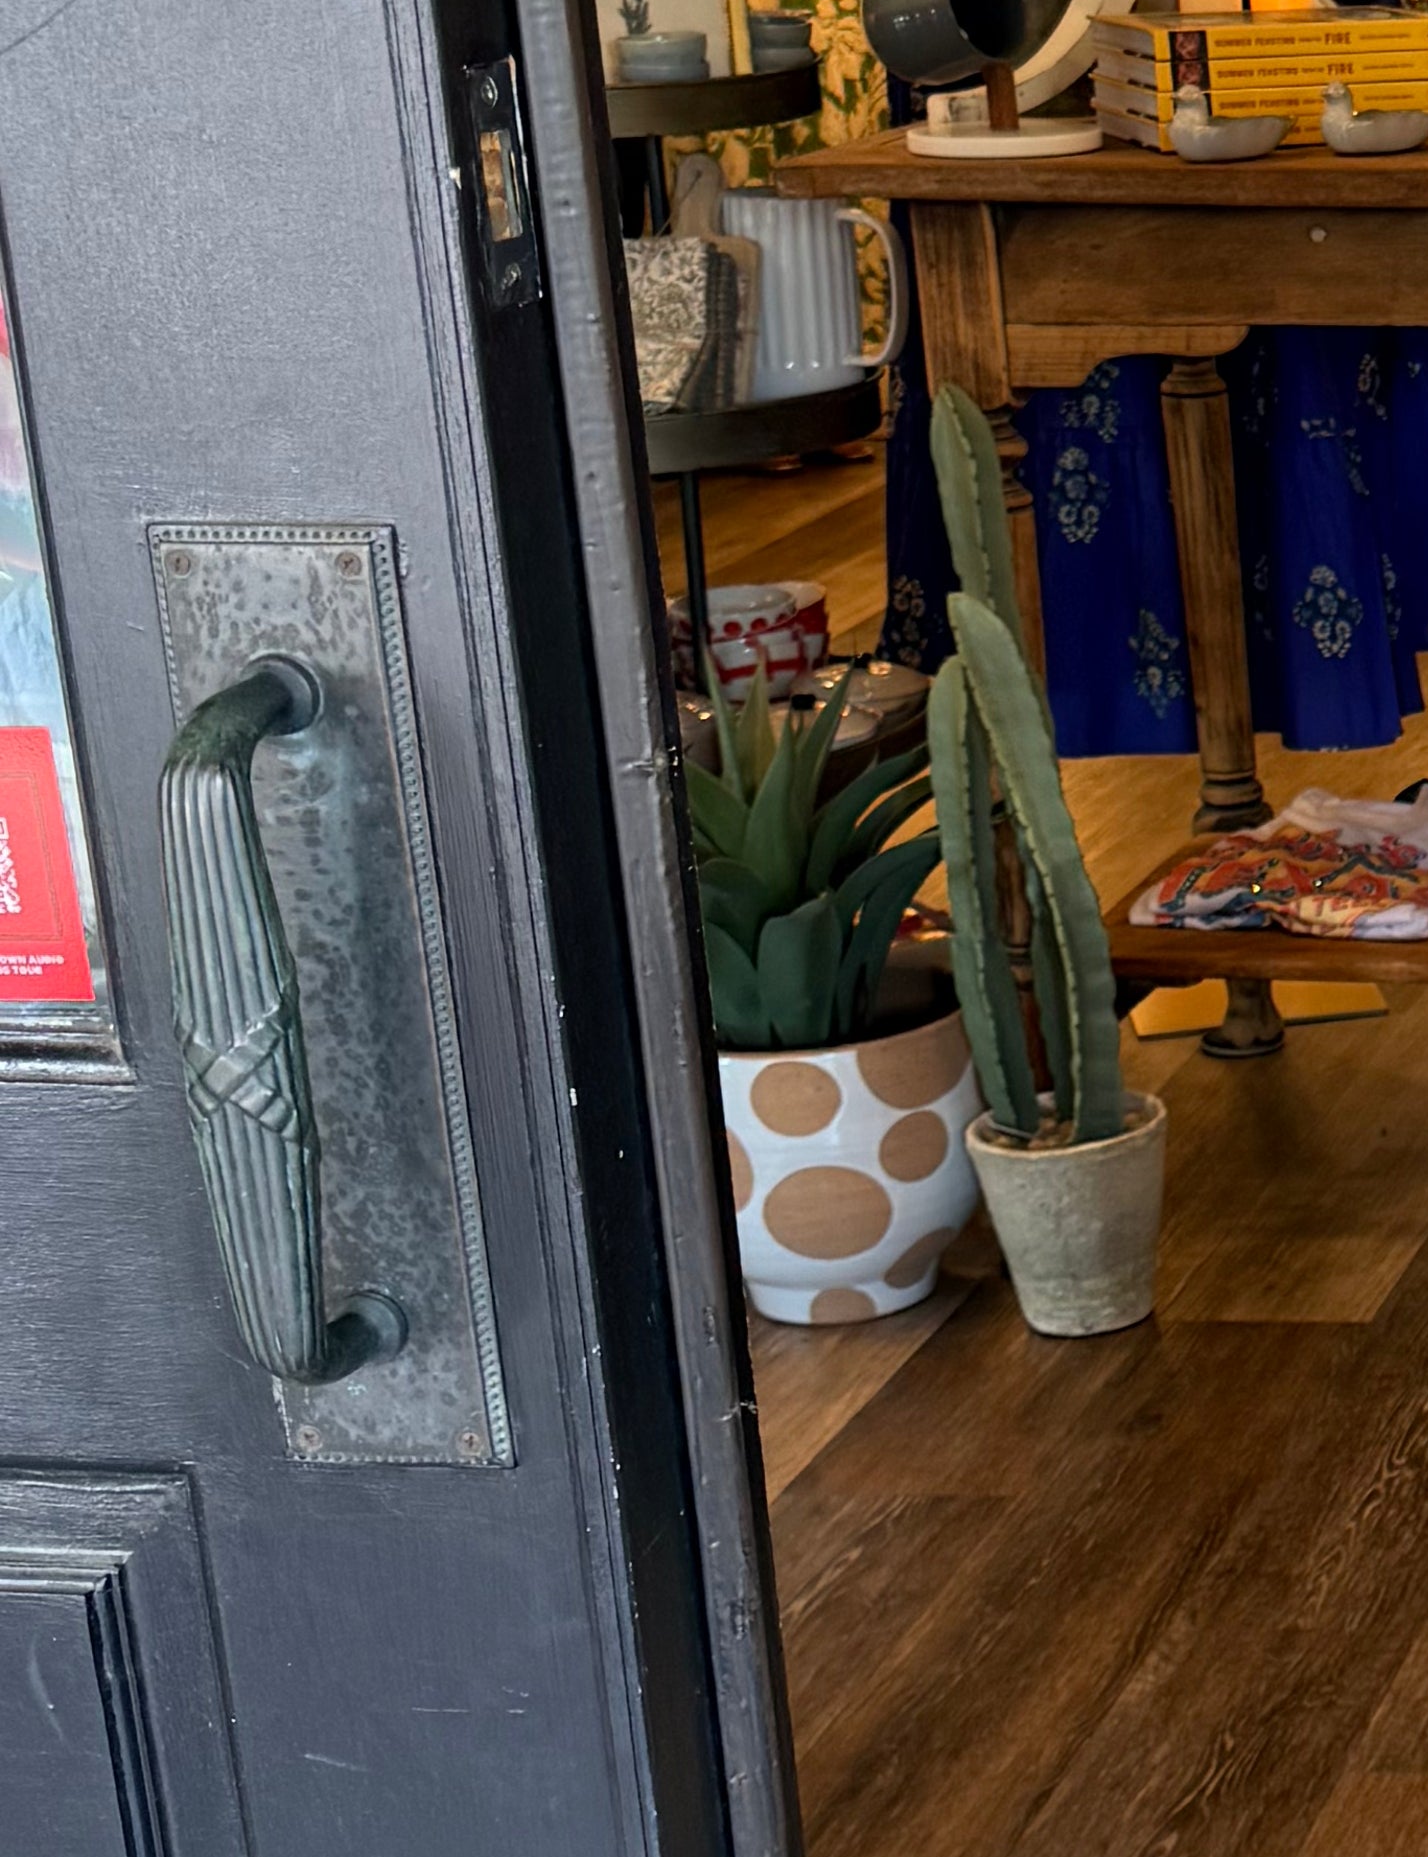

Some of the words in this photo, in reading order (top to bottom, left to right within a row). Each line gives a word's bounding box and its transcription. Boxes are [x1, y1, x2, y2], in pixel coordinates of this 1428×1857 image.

[1325, 31, 1351, 45] FIRE
[1327, 62, 1354, 75] FIRE
[28, 954, 64, 965] AUDIO
